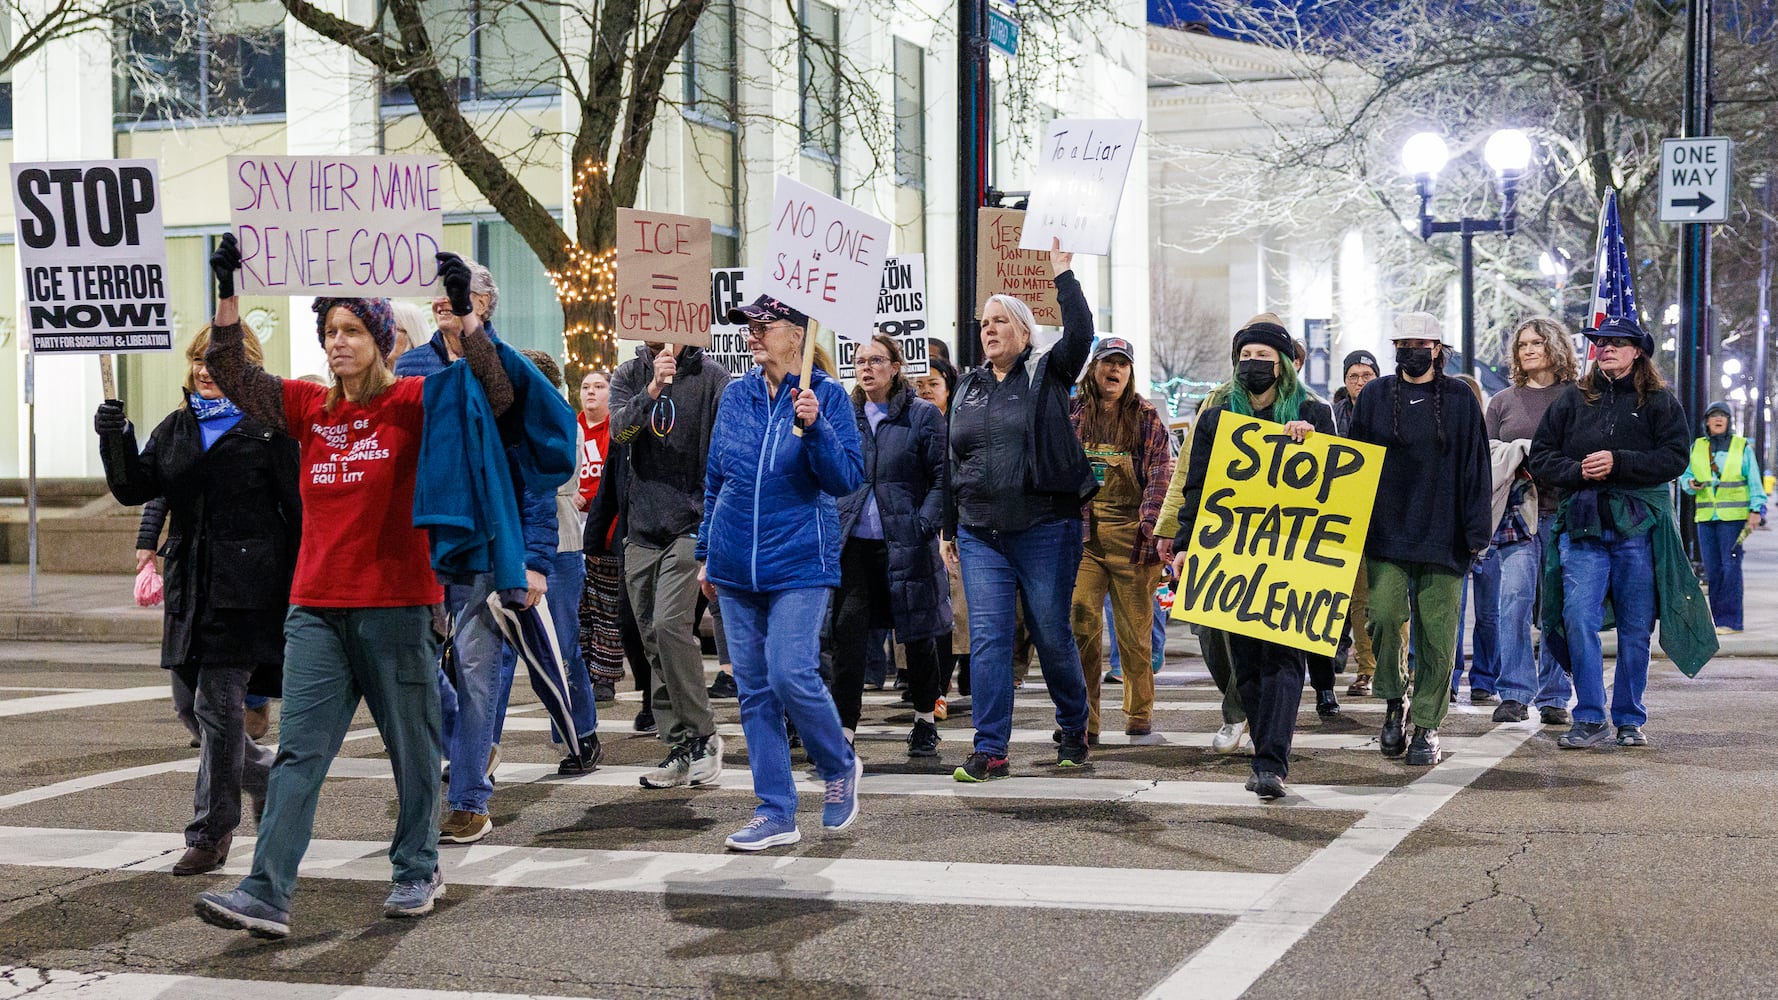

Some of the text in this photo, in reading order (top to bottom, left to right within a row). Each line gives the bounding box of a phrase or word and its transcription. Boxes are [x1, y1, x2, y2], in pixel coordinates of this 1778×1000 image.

[988, 16, 1008, 44] HIRD
[1052, 130, 1121, 162] To a Liar
[1674, 146, 1716, 165] ONE
[236, 160, 440, 213] SAY HER NAME
[1672, 168, 1718, 186] WAY
[17, 167, 155, 248] STOP
[634, 220, 691, 256] ICE
[777, 200, 874, 266] NO ONE
[990, 215, 1021, 251] JES
[239, 225, 440, 290] RENEE GOOD
[997, 262, 1045, 277] KILLING
[26, 264, 164, 301] ICE TERROR
[773, 252, 838, 302] SAFE
[1003, 278, 1056, 290] NO MATTE
[877, 293, 922, 314] APOLIS
[1023, 292, 1044, 301] THE
[1033, 307, 1056, 319] FOR
[30, 303, 167, 329] NOW!
[620, 294, 710, 334] GESTAPO
[35, 334, 169, 348] PARTY FOR SOCIALISM & LIBERATION
[722, 333, 733, 353] OF
[1226, 423, 1365, 504] STOP
[1198, 488, 1352, 568] STATE
[1184, 553, 1350, 646] VIOLENCE
